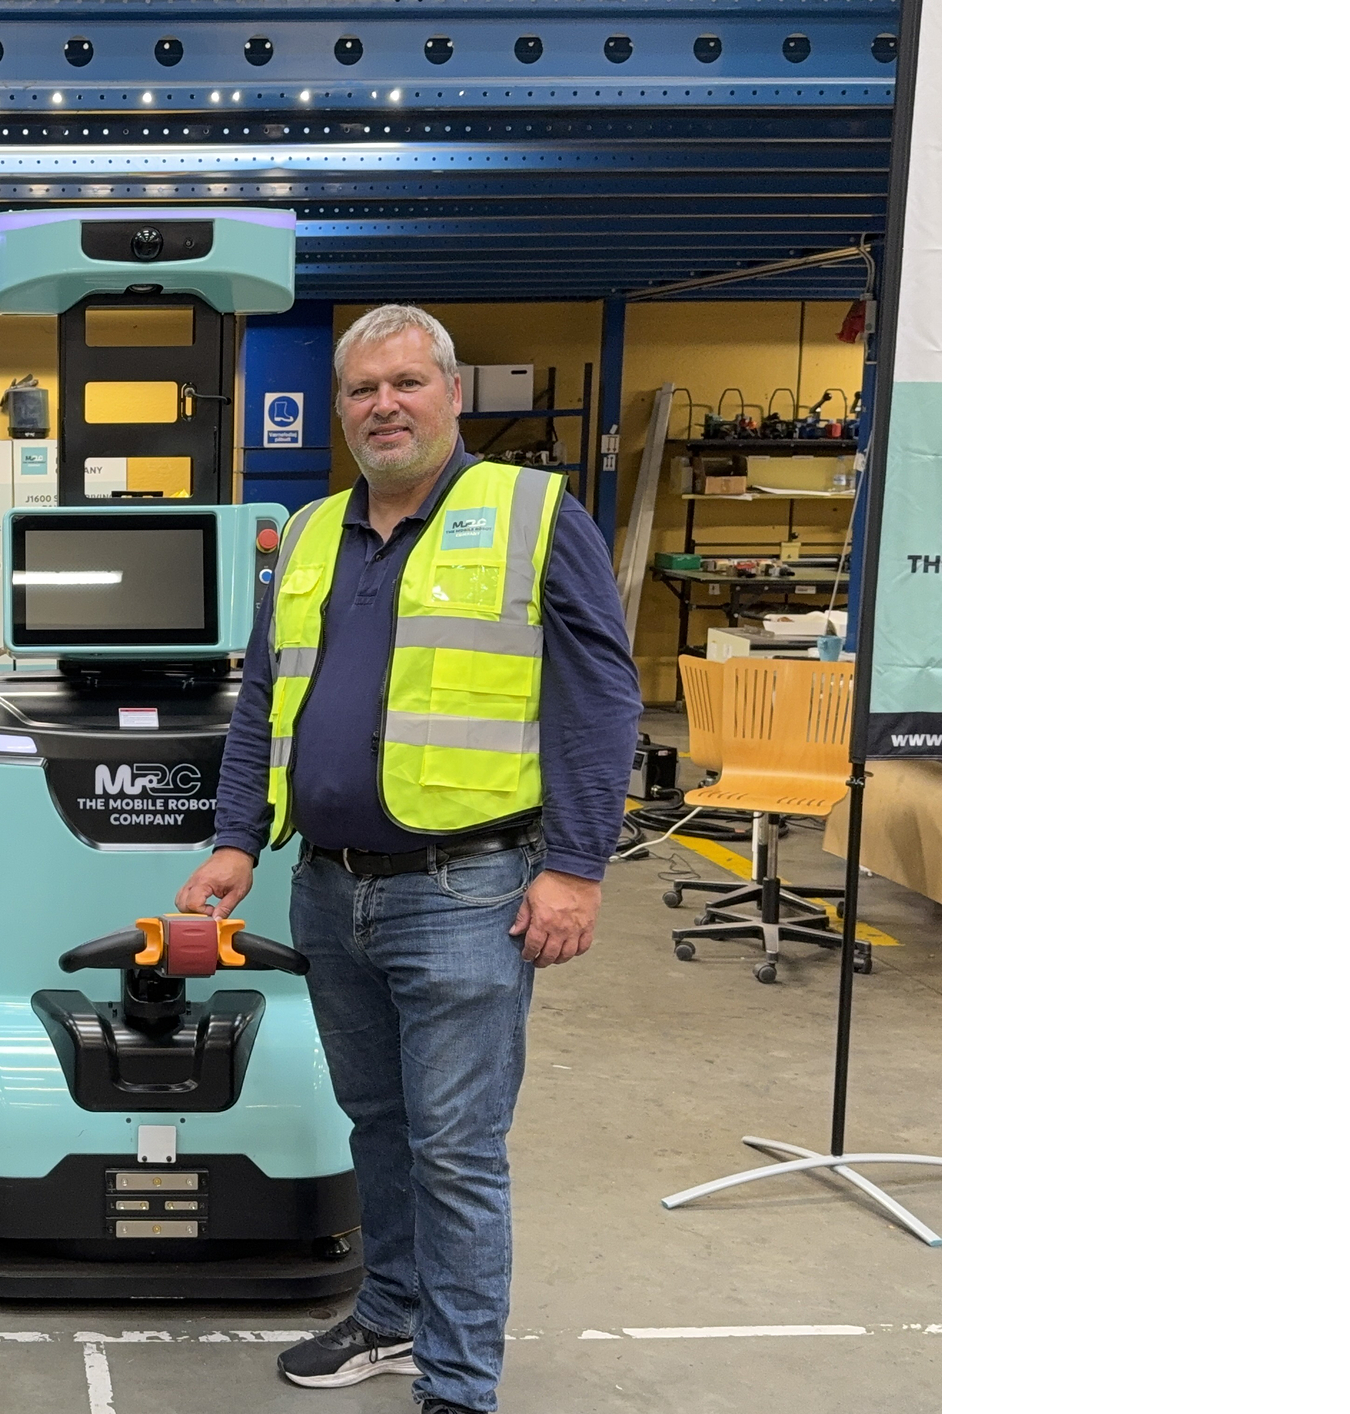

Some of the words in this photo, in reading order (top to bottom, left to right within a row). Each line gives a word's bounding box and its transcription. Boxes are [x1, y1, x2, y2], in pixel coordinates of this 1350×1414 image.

[25, 494, 52, 503] J1600
[77, 798, 106, 810] THE
[108, 798, 165, 811] MOBILE
[168, 799, 218, 811] ROBOT
[110, 813, 185, 826] COMPANY
